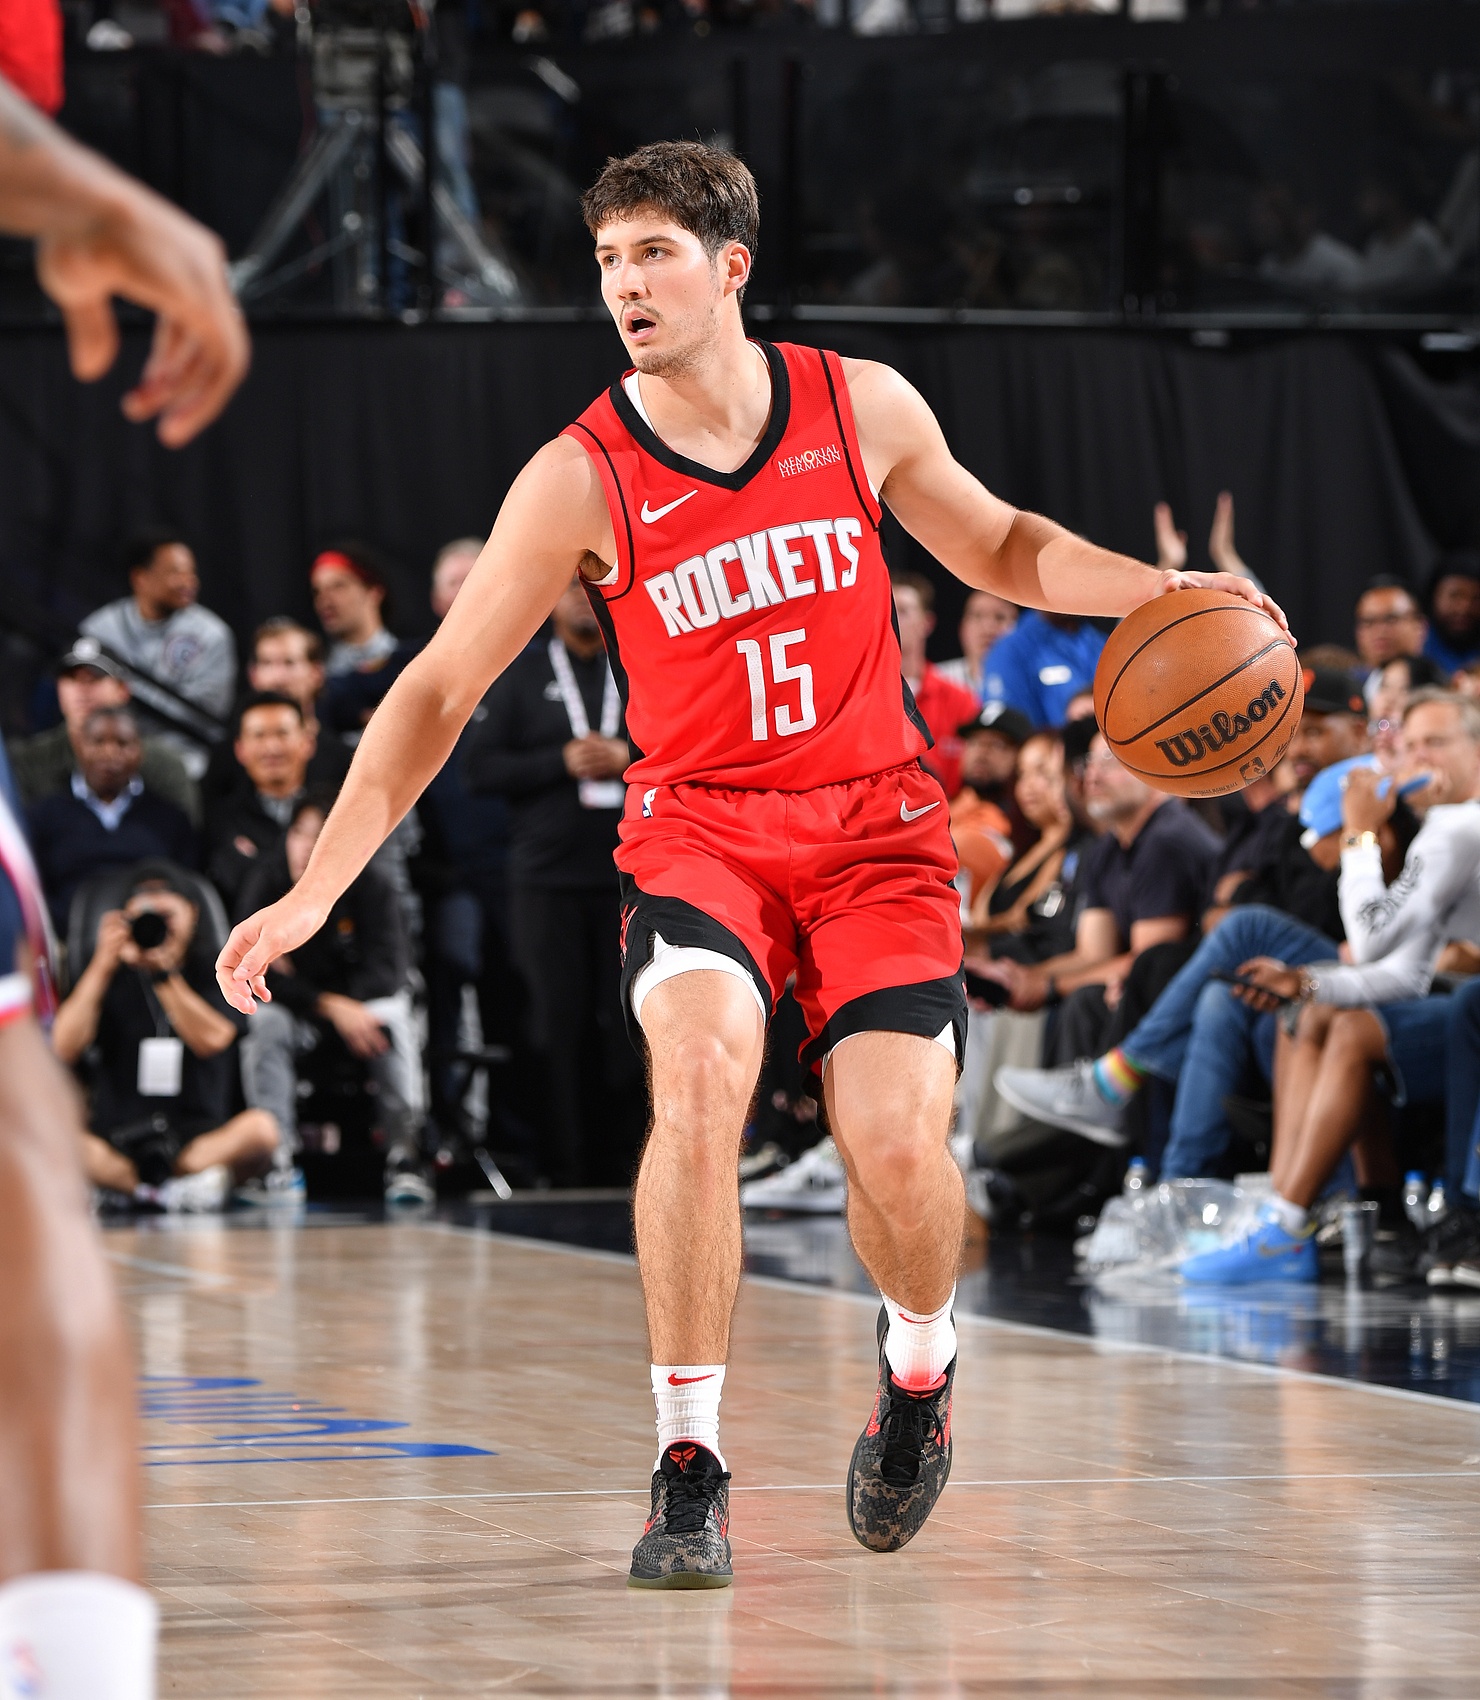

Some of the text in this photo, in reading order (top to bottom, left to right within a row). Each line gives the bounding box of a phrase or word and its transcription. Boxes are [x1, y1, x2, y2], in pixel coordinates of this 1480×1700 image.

[777, 444, 839, 469] MEMORIAL
[779, 451, 841, 478] HERMANN
[643, 517, 863, 639] ROCKETS
[736, 628, 817, 741] 15
[1155, 679, 1287, 767] Wilson
